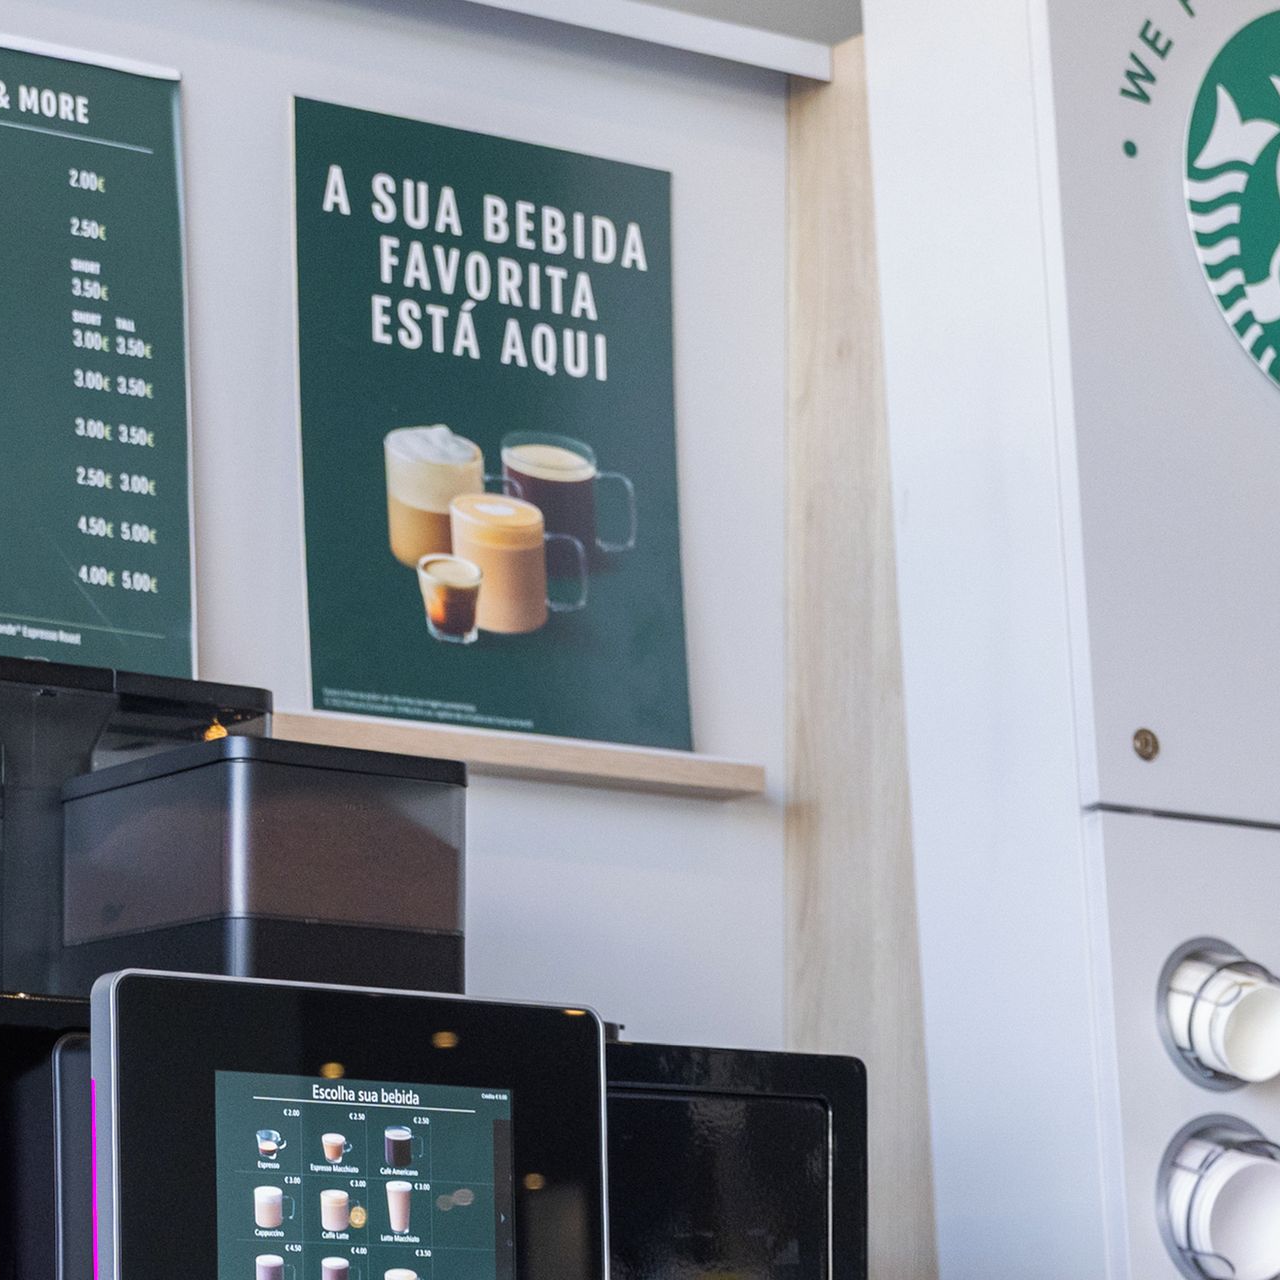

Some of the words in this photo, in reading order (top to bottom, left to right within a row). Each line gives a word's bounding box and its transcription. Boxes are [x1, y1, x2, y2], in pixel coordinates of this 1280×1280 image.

[1119, 18, 1174, 105] WE
[19, 84, 90, 124] MORE
[69, 168, 106, 193] 2.00€
[70, 216, 107, 241] 2.50€
[322, 164, 352, 215] A
[371, 172, 463, 237] SUA
[483, 193, 648, 272] BEBIDA
[71, 277, 109, 301] 3.50€
[379, 235, 598, 321] FAVORITA
[72, 328, 110, 352] 3.00€
[115, 335, 152, 359] 3.50€
[371, 293, 481, 360] ESTÁ
[500, 317, 608, 381] AQUI
[73, 368, 112, 392] 3.00€
[117, 375, 154, 399] 3.50€
[74, 417, 113, 441] 3.00€
[118, 424, 155, 448] 3.50€
[75, 465, 113, 490] 2.50€
[119, 472, 157, 496] 3.00€
[77, 515, 114, 539] 4.50€
[120, 521, 157, 545] 5.00€
[78, 564, 115, 588] 4.00€
[121, 570, 158, 594] 5.00€
[312, 1084, 355, 1101] Escolha
[358, 1089, 379, 1102] sua
[381, 1088, 420, 1105] bebida
[257, 1161, 280, 1169] Espresso
[310, 1163, 332, 1172] Espresso
[254, 1229, 284, 1237] Cappuccino
